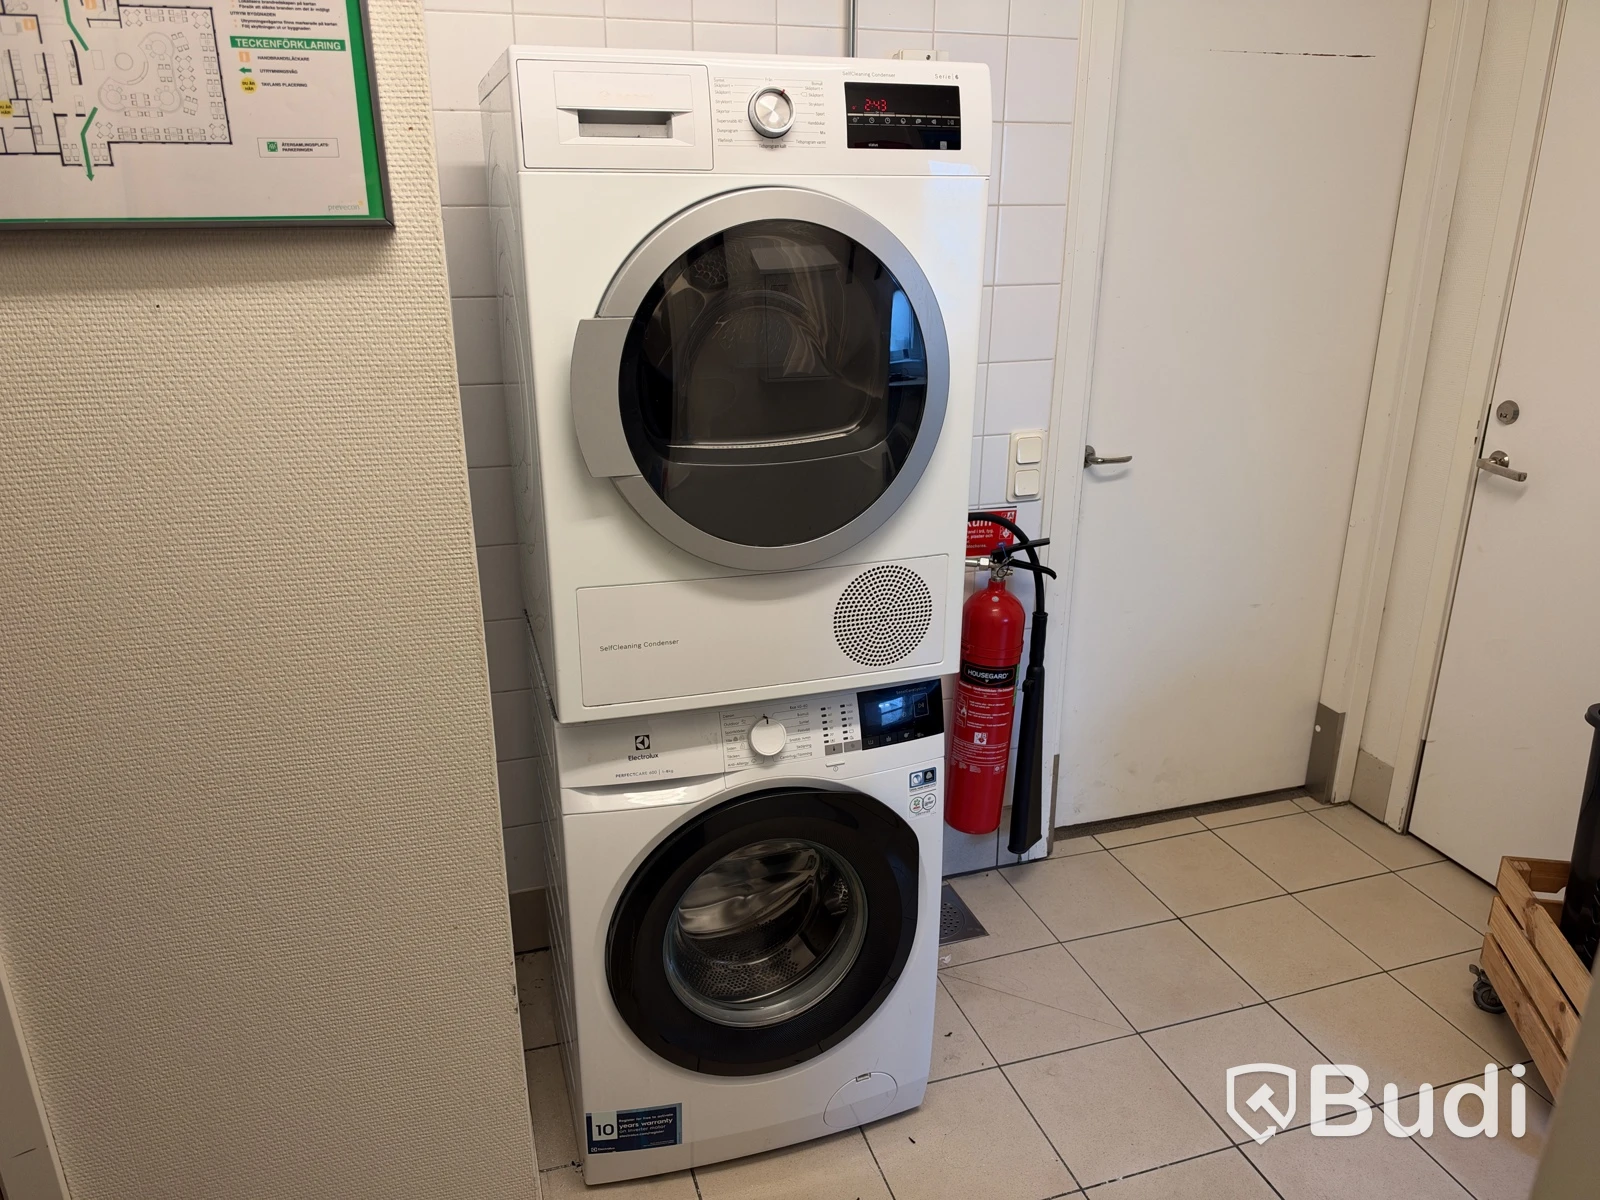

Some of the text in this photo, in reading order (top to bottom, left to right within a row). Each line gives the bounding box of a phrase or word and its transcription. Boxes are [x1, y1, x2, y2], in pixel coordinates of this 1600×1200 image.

[235, 38, 341, 50] TECKENFÖRKLARING
[600, 640, 679, 652] SelfCleaning Condenser
[967, 669, 1008, 679] HOUSEGARD
[628, 753, 659, 761] Electrolux
[595, 1124, 614, 1136] 10
